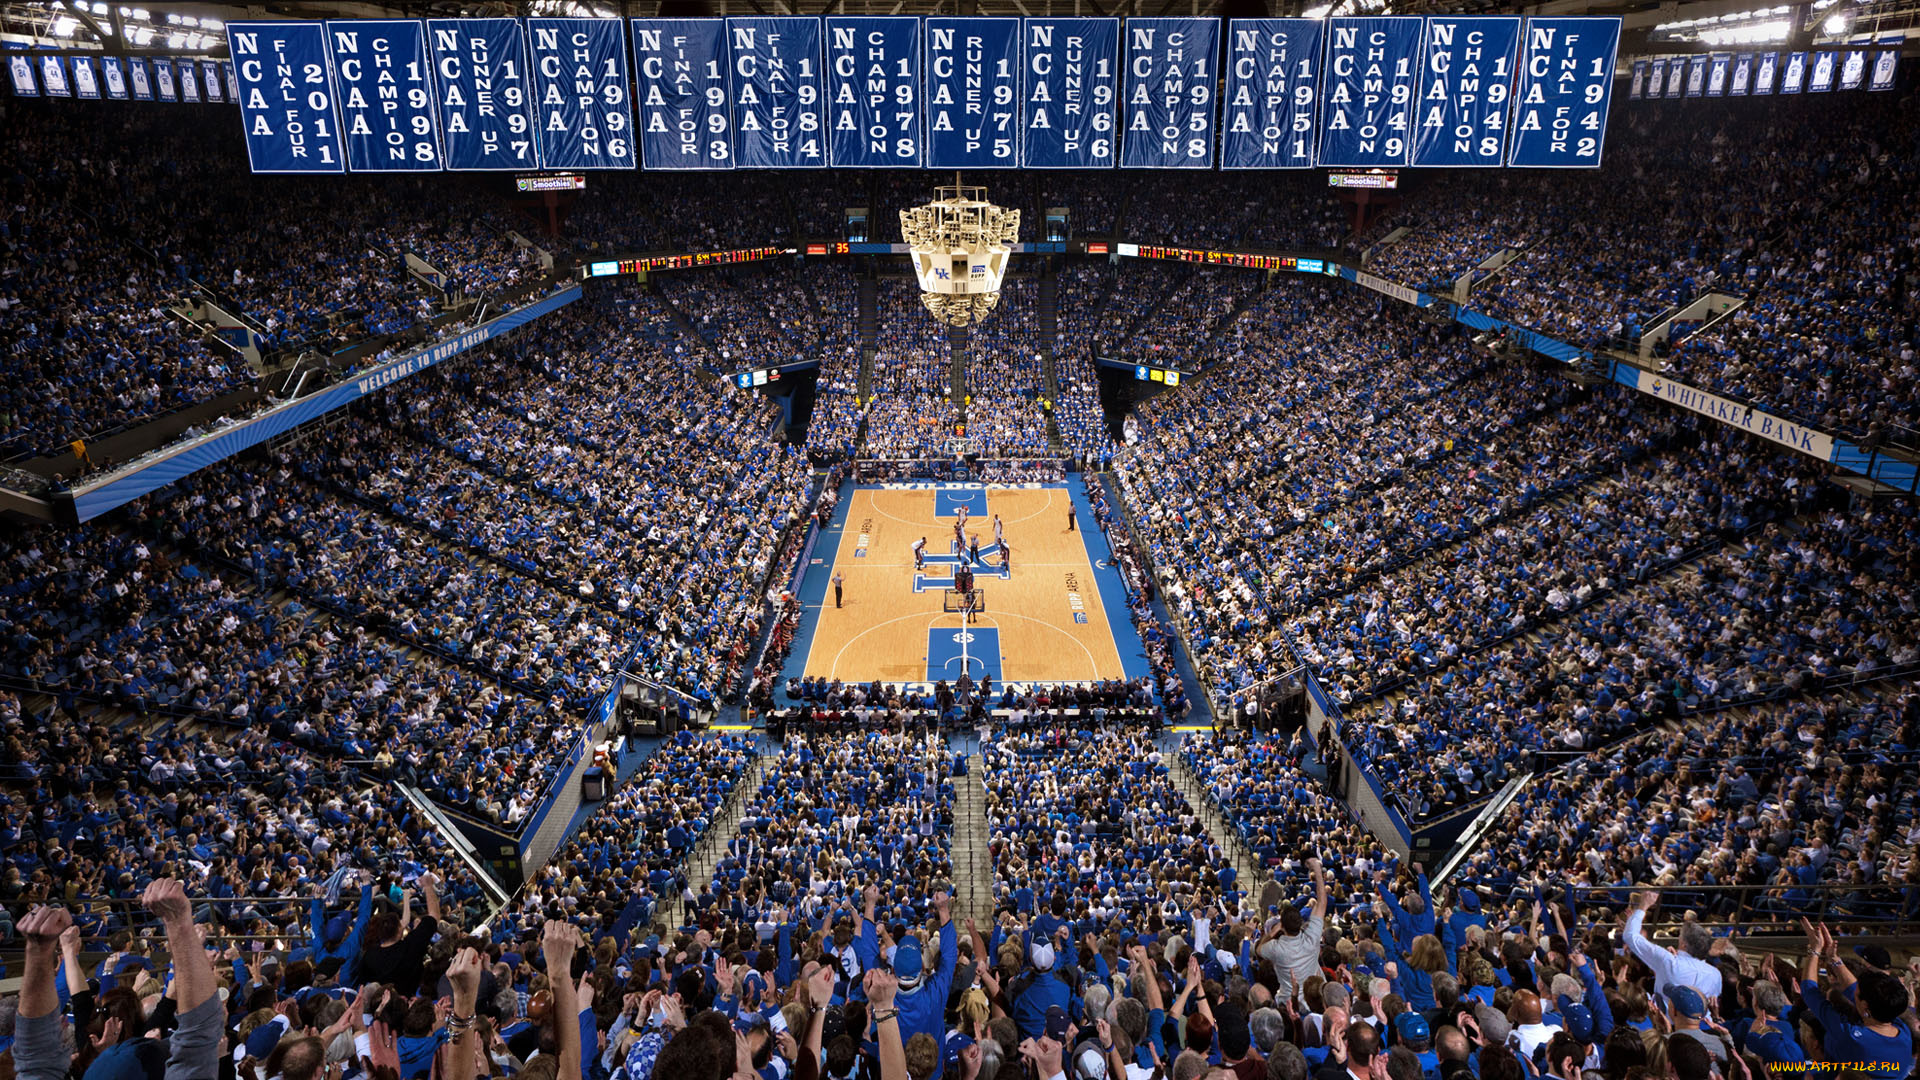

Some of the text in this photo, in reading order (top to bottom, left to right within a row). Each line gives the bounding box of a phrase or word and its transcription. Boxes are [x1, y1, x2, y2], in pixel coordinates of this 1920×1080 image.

[235, 33, 273, 135] NCAA
[274, 40, 307, 157] FINAL FOUR
[304, 64, 334, 162] 2011
[335, 32, 372, 134] NCAA
[373, 39, 405, 159] CHAMPION
[407, 62, 434, 161] 1998
[435, 30, 469, 132] NCAA
[471, 38, 498, 154] RUNNER UP
[503, 61, 528, 159] 1997
[536, 29, 568, 131] NCAA
[572, 34, 598, 154] CHAMPION
[604, 58, 626, 157] 1996
[639, 30, 668, 132] NCAA
[674, 36, 697, 154] FINAL FOUR
[706, 60, 728, 159] 1993
[734, 28, 761, 130] NCAA
[768, 34, 789, 152] FINAL FOUR
[798, 58, 819, 157] 1984
[833, 28, 856, 130] NCAA
[868, 32, 887, 152] CHAMPION
[896, 58, 915, 157] 1978
[933, 29, 954, 130] NCAA
[966, 37, 982, 152] RUNNER UP
[993, 59, 1012, 157] 1975
[1030, 26, 1054, 128] NCAA
[1065, 37, 1082, 152] RUNNER UP
[1092, 59, 1111, 157] 1966
[1130, 29, 1155, 130] NCAA
[1163, 33, 1183, 153] CHAMPION
[1188, 59, 1208, 157] 1958
[1230, 30, 1259, 132] NCAA
[1264, 33, 1287, 154] CHAMPION
[1292, 60, 1313, 157] 1951
[1329, 28, 1358, 129] NCAA
[1360, 32, 1385, 152] CHAMPION
[1386, 58, 1409, 156] 1949
[1423, 24, 1456, 127] NCAA
[1454, 32, 1483, 152] CHAMPION
[1480, 56, 1507, 156] 1948
[1521, 28, 1555, 130] NCAA
[1551, 35, 1578, 152] FINAL FOUR
[1576, 58, 1603, 156] 1942
[533, 180, 570, 188] Smoothies
[1342, 176, 1381, 186] Smoothies
[836, 242, 849, 253] 35
[1395, 286, 1413, 302] BANK
[358, 328, 489, 394] WELCOME TO RUPP ARENA
[1666, 382, 1816, 451] WHITAKER BANK
[1065, 572, 1085, 609] RUPP ARENA
